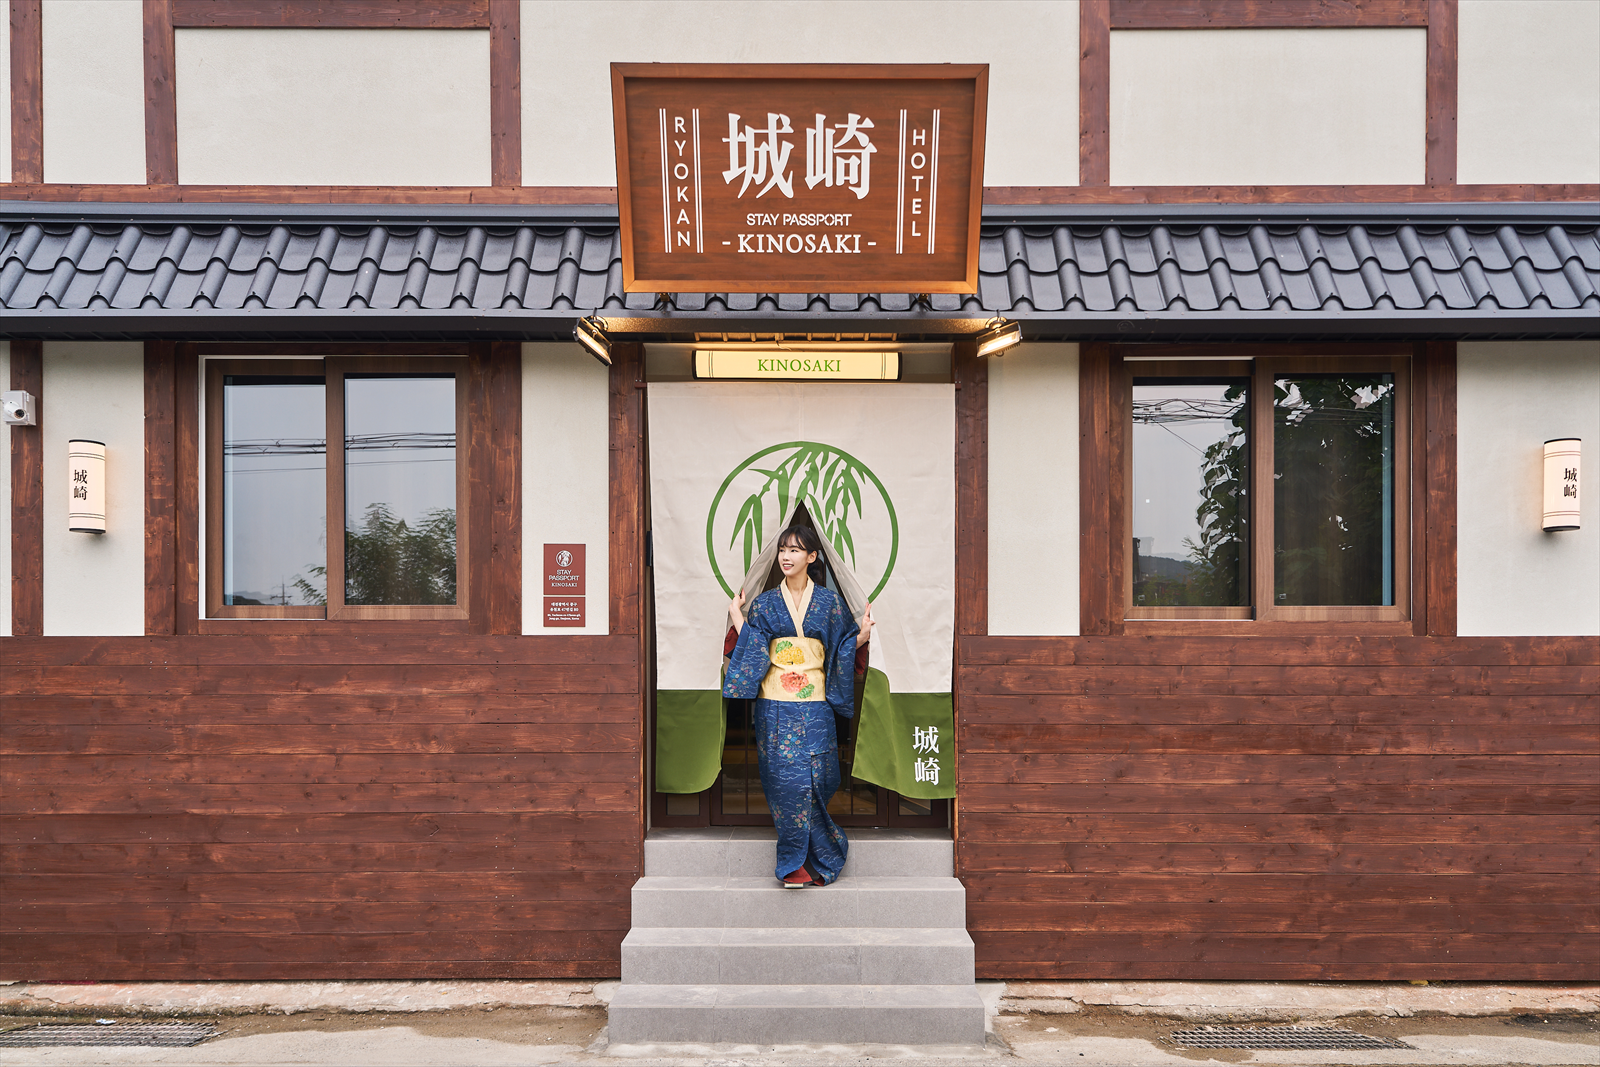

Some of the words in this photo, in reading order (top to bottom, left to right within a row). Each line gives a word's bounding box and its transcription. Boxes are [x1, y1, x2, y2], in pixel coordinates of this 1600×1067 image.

[722, 112, 878, 200] 城崎
[673, 116, 691, 247] RYOKAN
[910, 128, 926, 237] HOTEL
[746, 213, 779, 227] STAY
[782, 213, 853, 227] PASSPORT
[737, 233, 862, 254] KINOSAKI
[757, 358, 842, 373] KINOSAKI
[73, 469, 88, 501] 城崎
[1563, 467, 1578, 499] 城崎
[912, 725, 941, 786] 城崎
